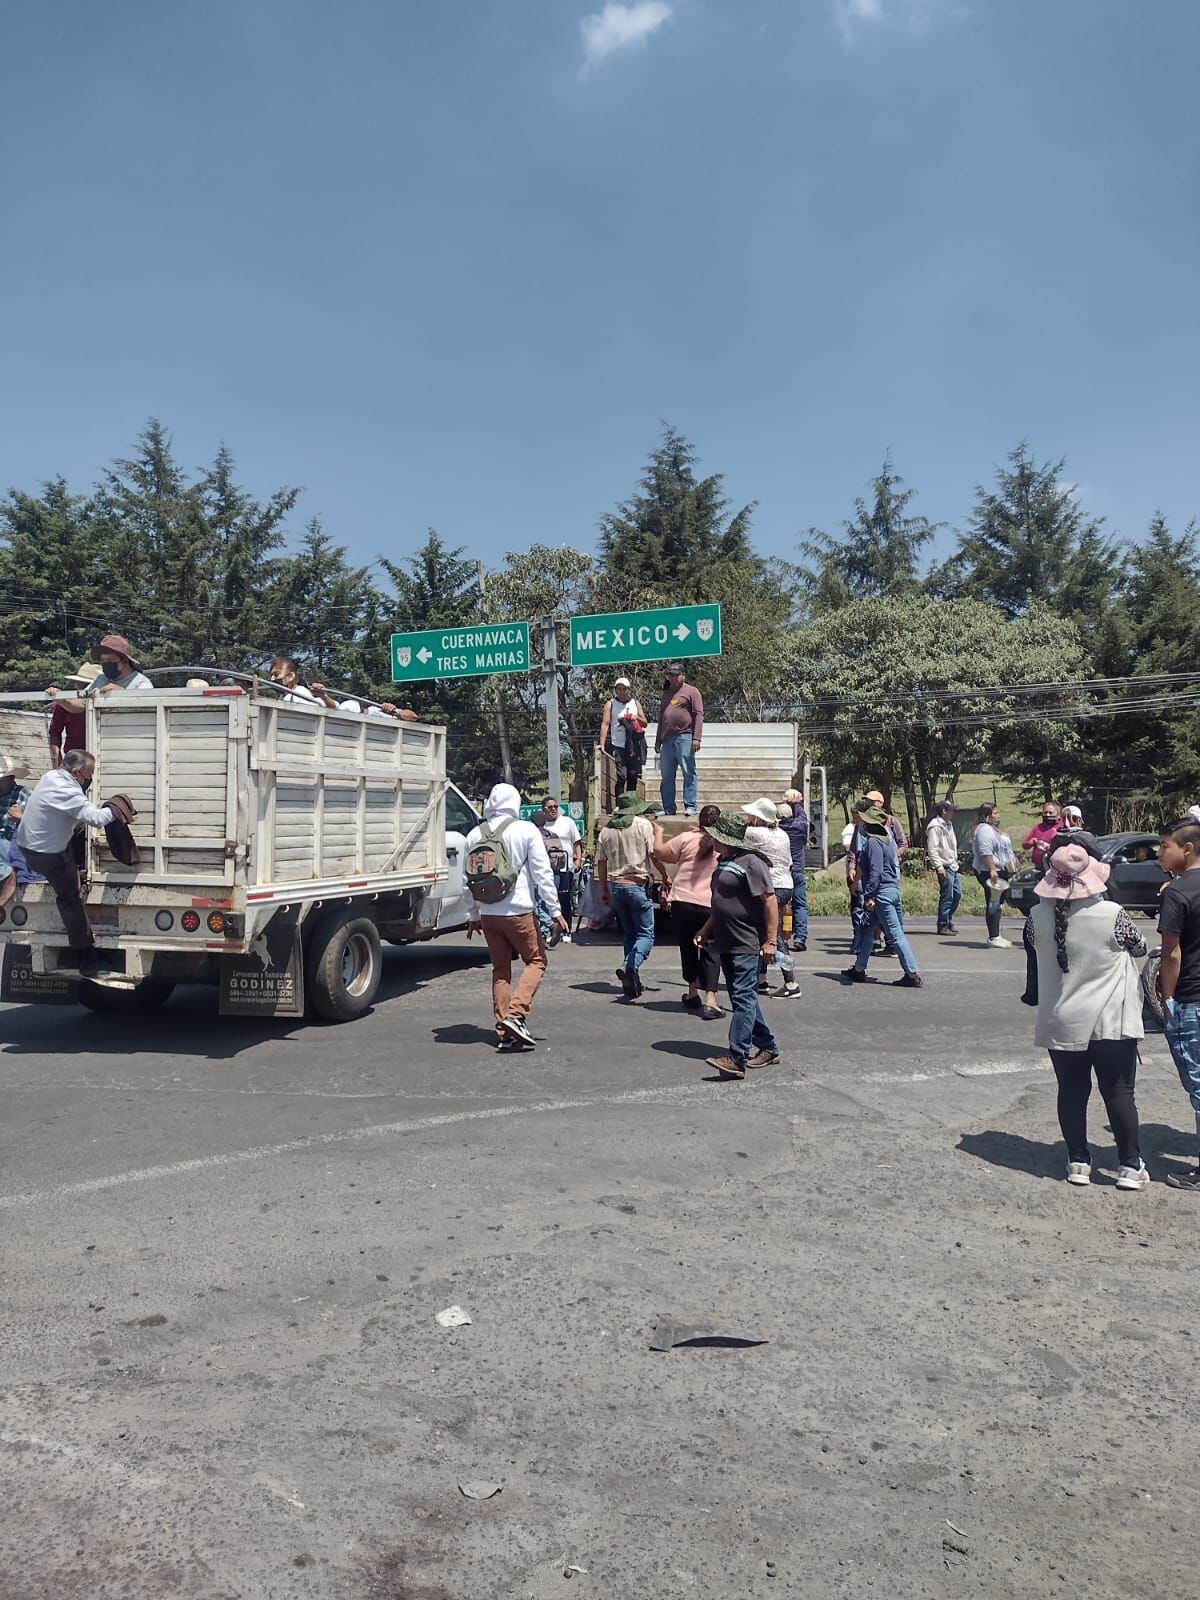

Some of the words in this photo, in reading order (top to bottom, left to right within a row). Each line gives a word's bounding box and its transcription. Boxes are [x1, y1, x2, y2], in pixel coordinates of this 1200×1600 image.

[441, 629, 523, 650] CUERNAVACA
[576, 624, 668, 651] MEXICO
[436, 655, 468, 671] TRES
[475, 650, 524, 667] MARIAS
[230, 978, 293, 989] GODINEZ
